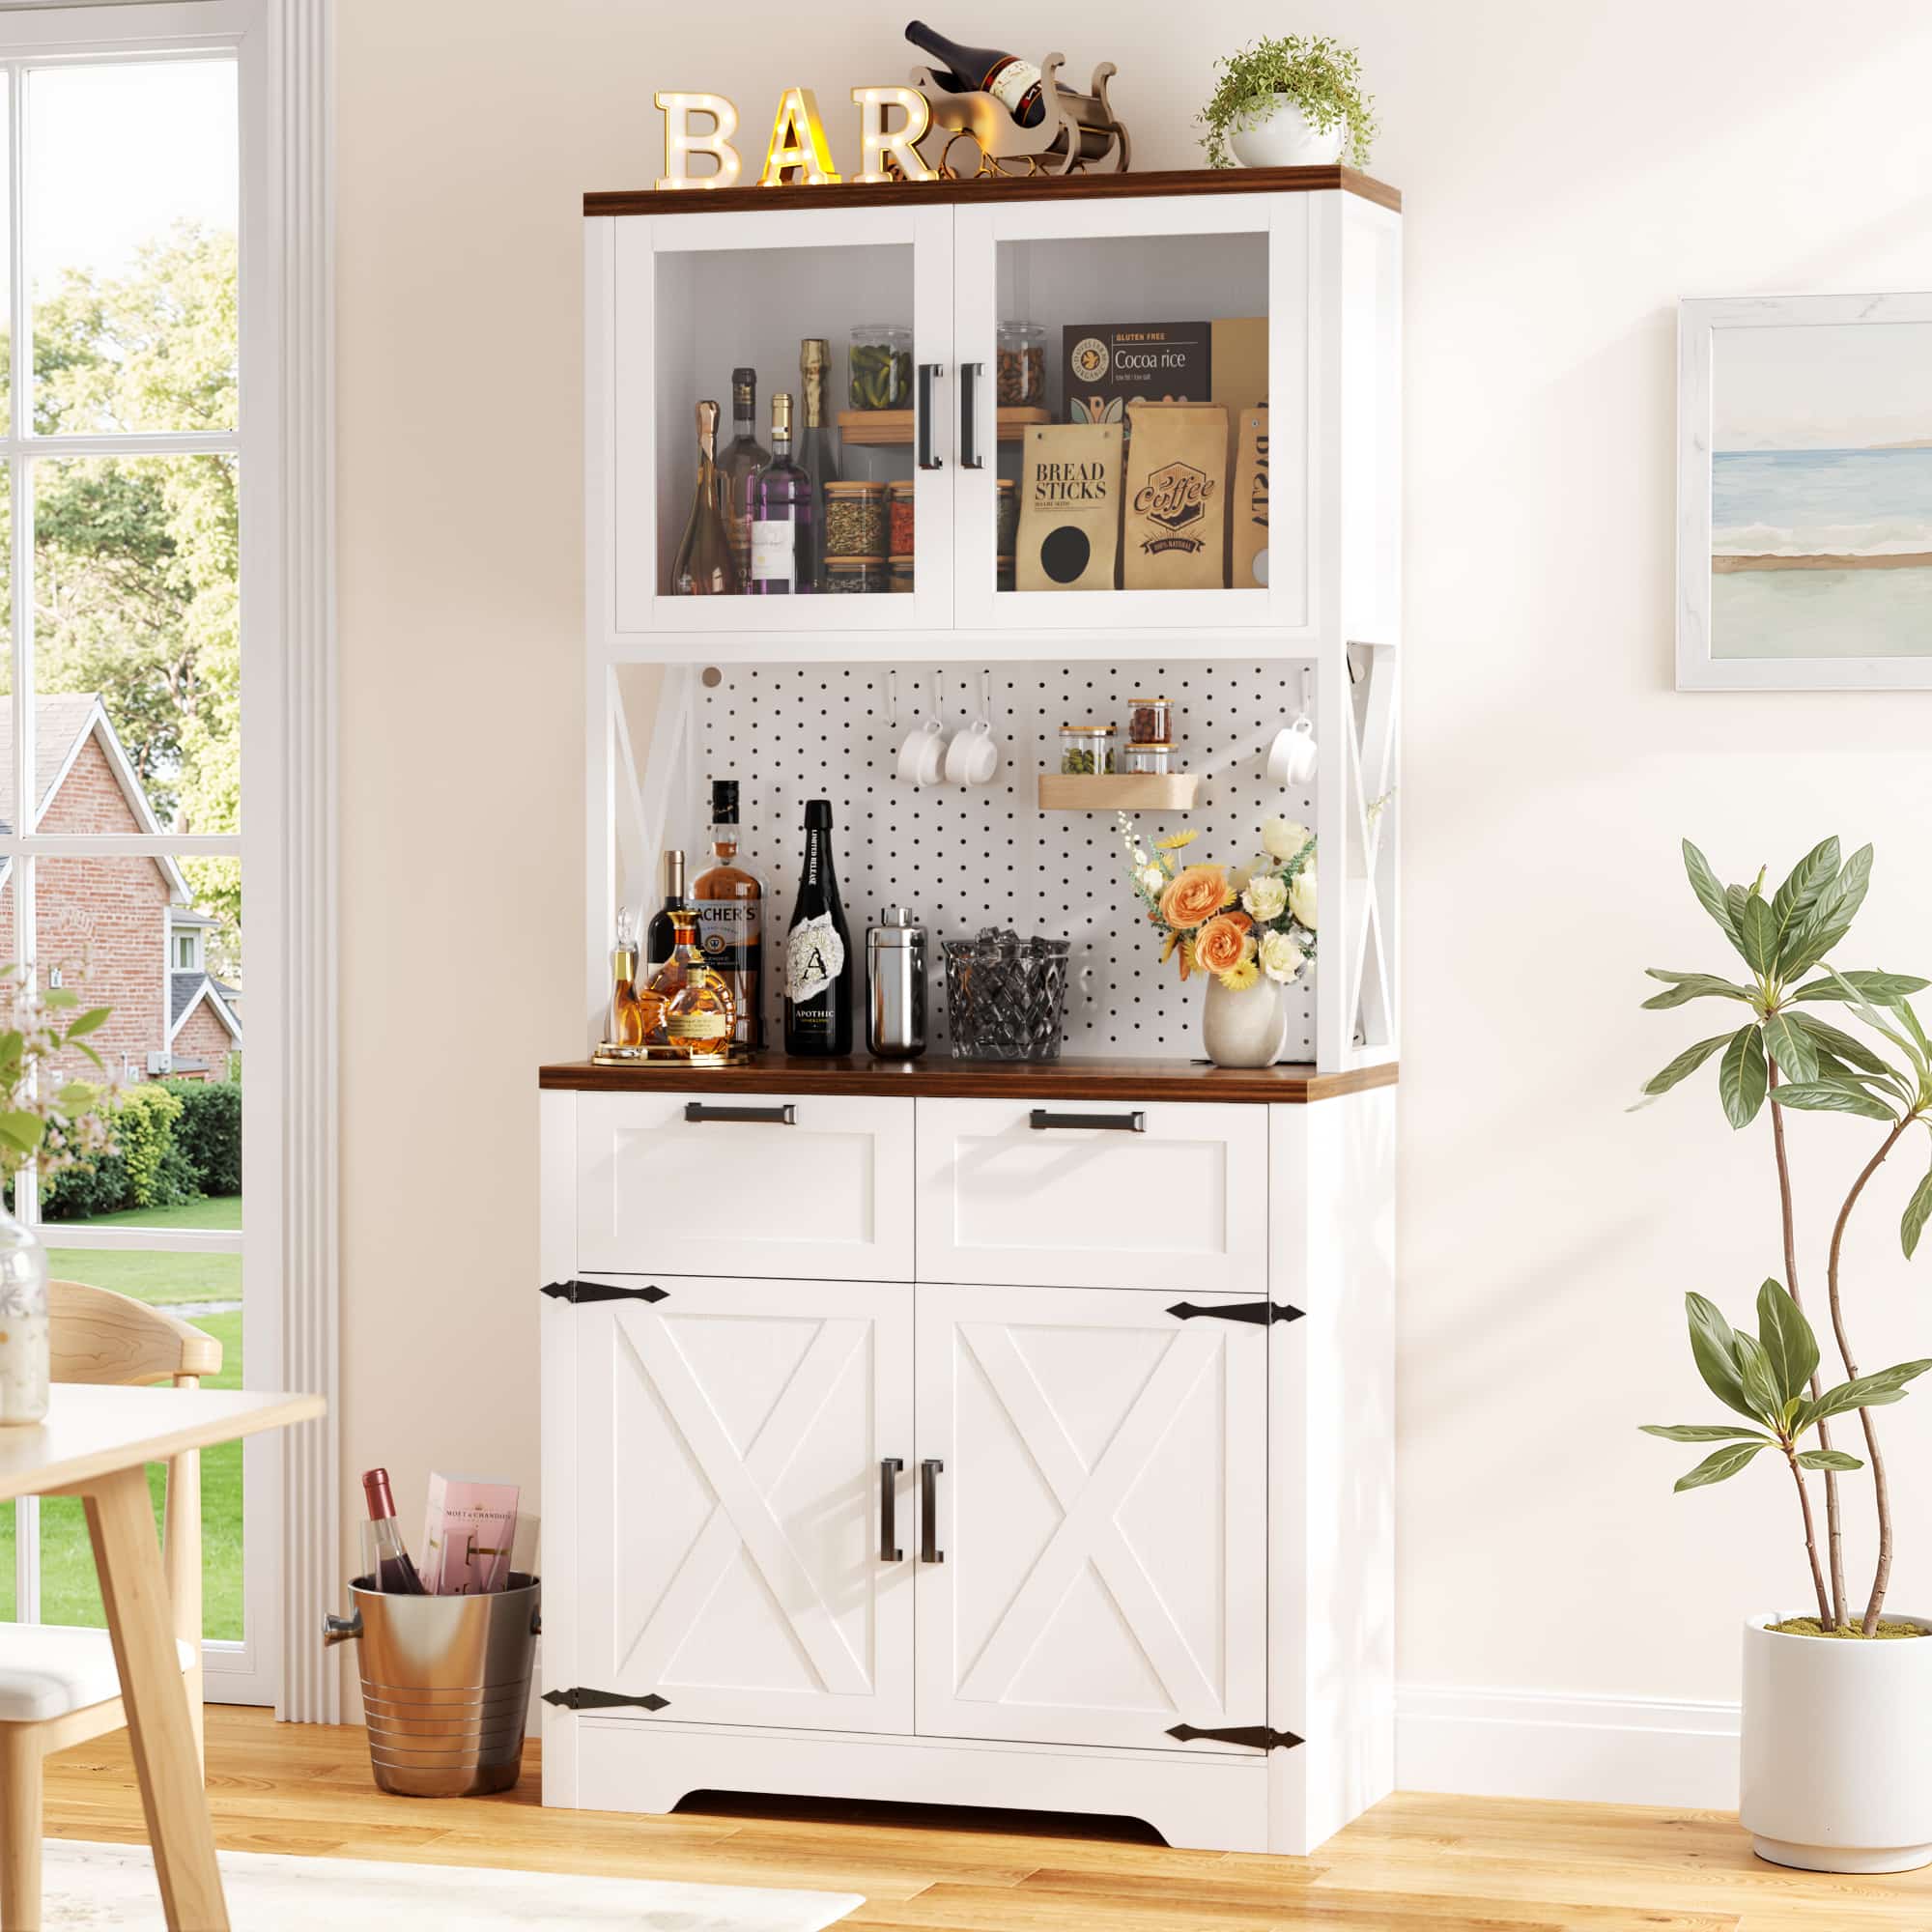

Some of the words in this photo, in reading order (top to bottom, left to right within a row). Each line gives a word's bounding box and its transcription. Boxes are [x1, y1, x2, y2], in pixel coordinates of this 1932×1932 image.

[655, 85, 939, 189] BAR
[1147, 331, 1167, 340] FREE
[1115, 350, 1157, 369] Cocoa
[1161, 349, 1186, 367] rice
[1036, 462, 1105, 481] BREAD
[1035, 482, 1106, 500] STICKS
[1134, 476, 1214, 512] Coffee
[809, 857, 817, 886] RELEASE
[696, 906, 755, 922] ACHER'S
[802, 947, 828, 980] A
